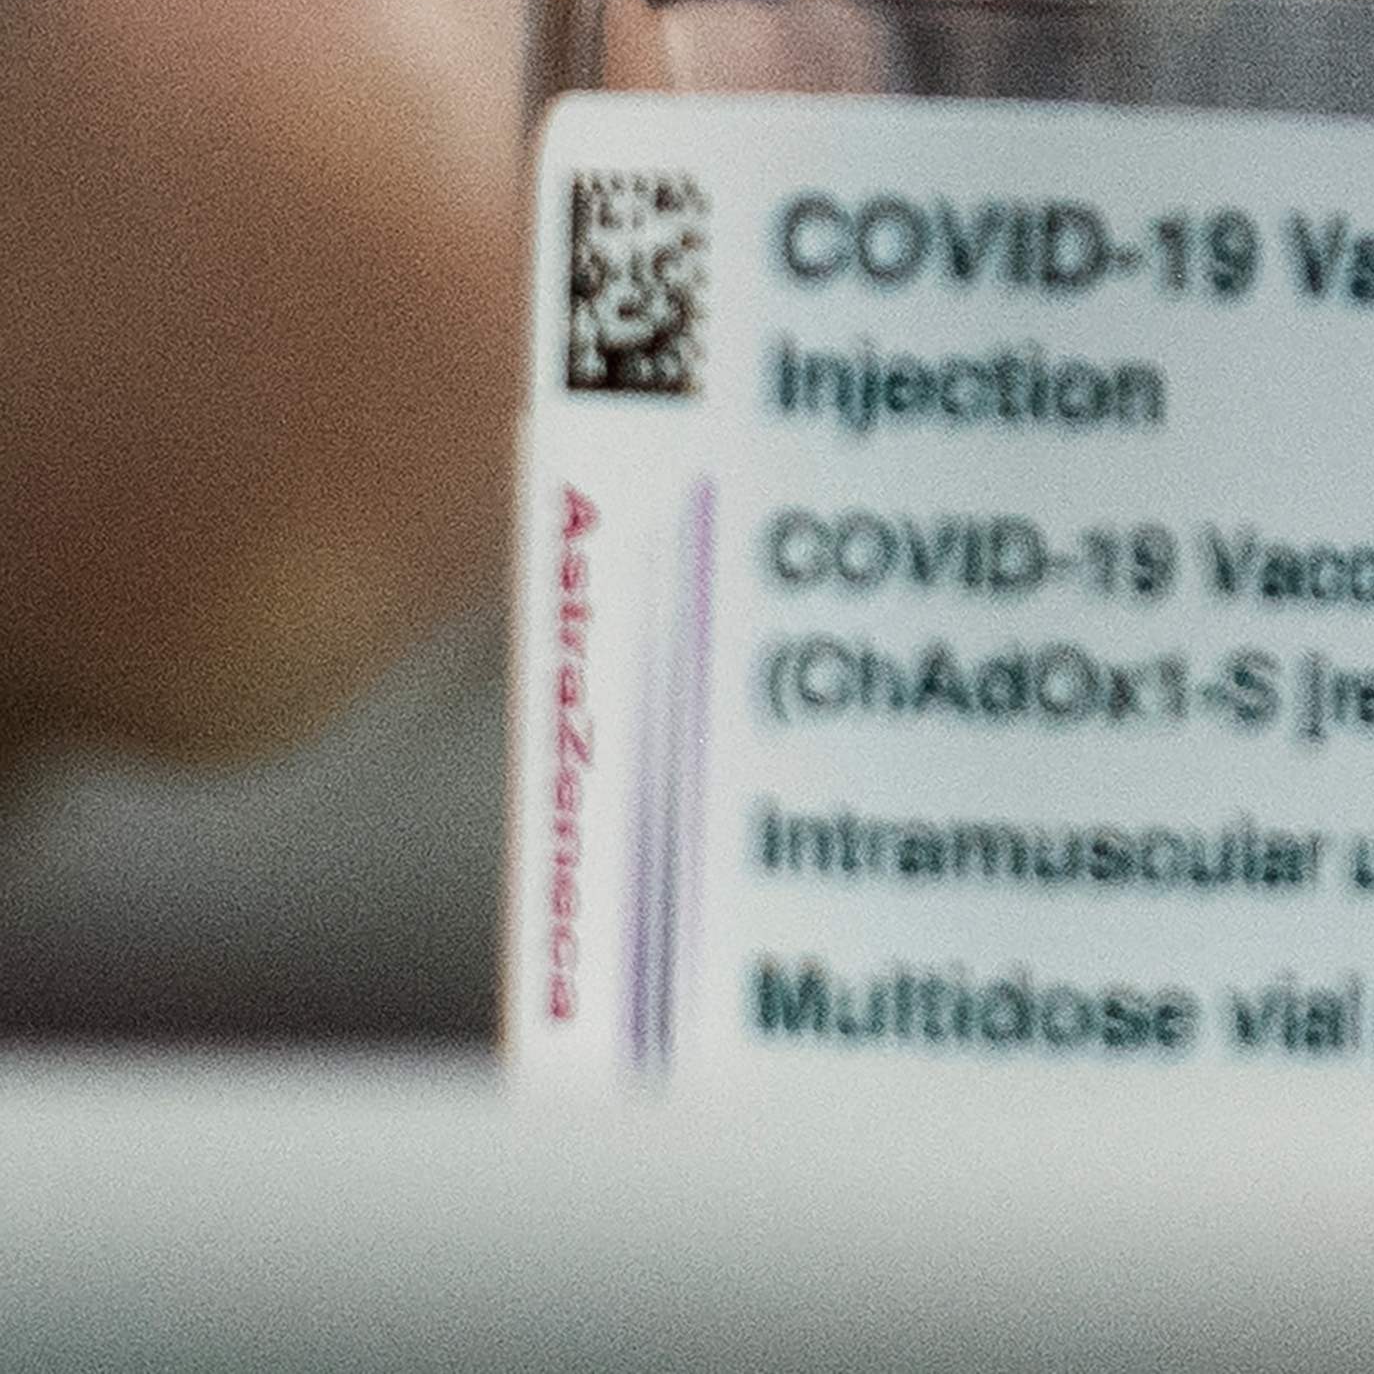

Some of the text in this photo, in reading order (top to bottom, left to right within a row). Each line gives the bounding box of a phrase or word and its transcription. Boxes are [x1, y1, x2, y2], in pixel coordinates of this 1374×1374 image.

[773, 191, 1264, 307] COVID-19
[772, 333, 1168, 438] Injection
[766, 509, 1180, 605] COVID-19
[760, 632, 1281, 732] (ChAdOx1-S
[545, 482, 600, 1024] AstraZeneca
[756, 804, 1328, 895] Intramuscular
[751, 956, 1200, 1056] Multidose
[1227, 966, 1363, 1056] vial
